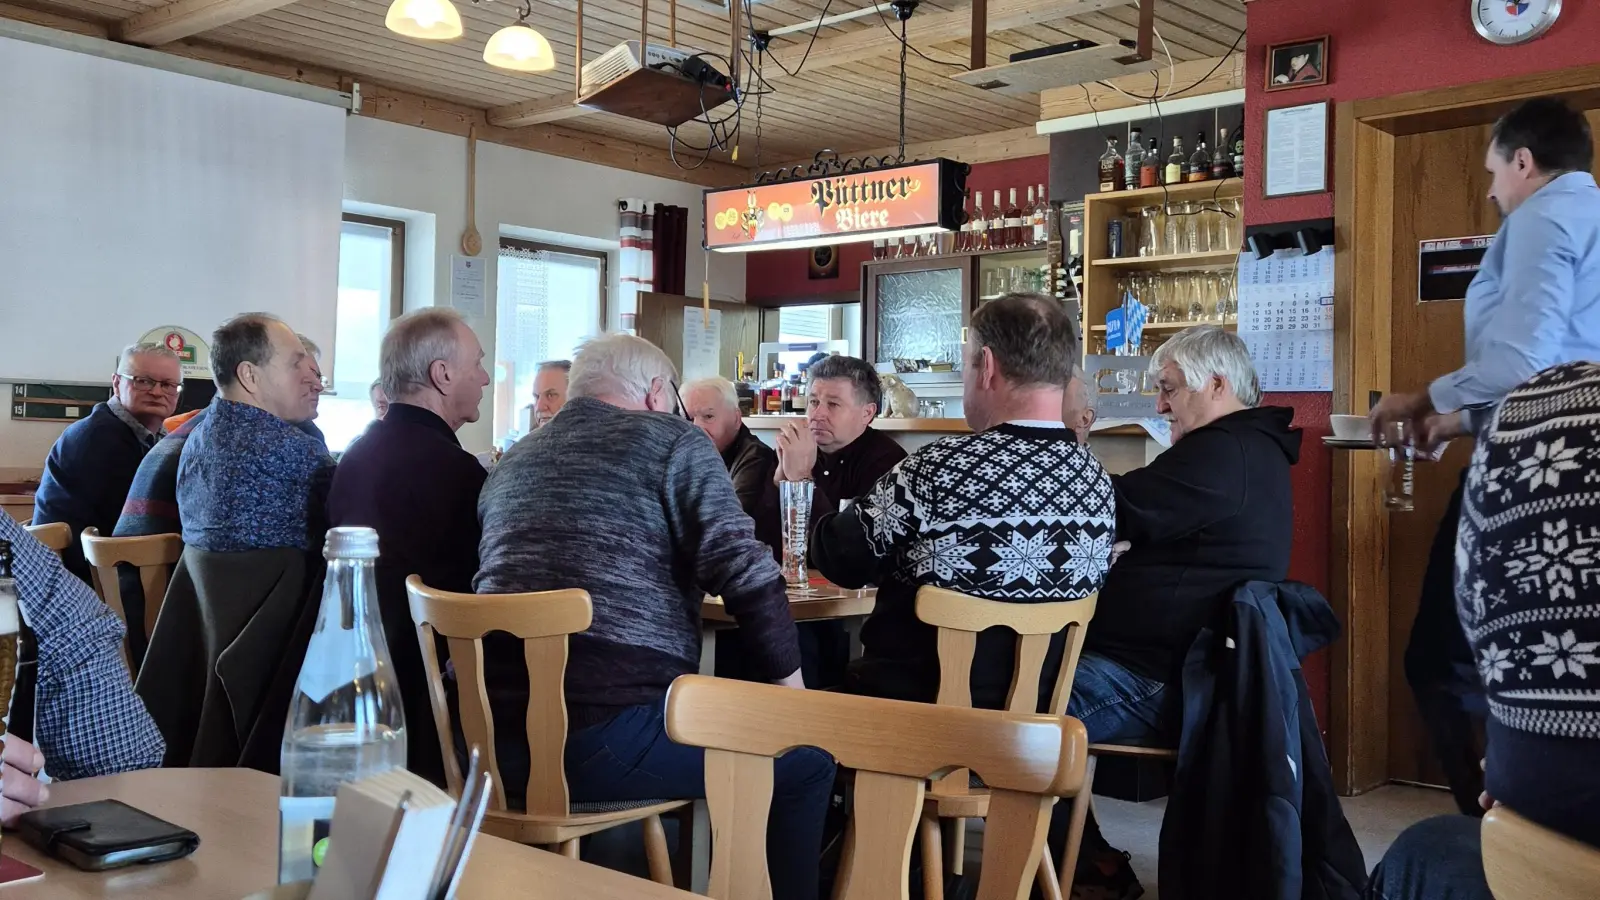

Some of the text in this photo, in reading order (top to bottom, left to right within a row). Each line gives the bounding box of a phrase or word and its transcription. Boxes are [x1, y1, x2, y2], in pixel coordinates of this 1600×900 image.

[835, 206, 889, 231] Biere
[15, 386, 23, 395] 14
[14, 405, 23, 415] 15
